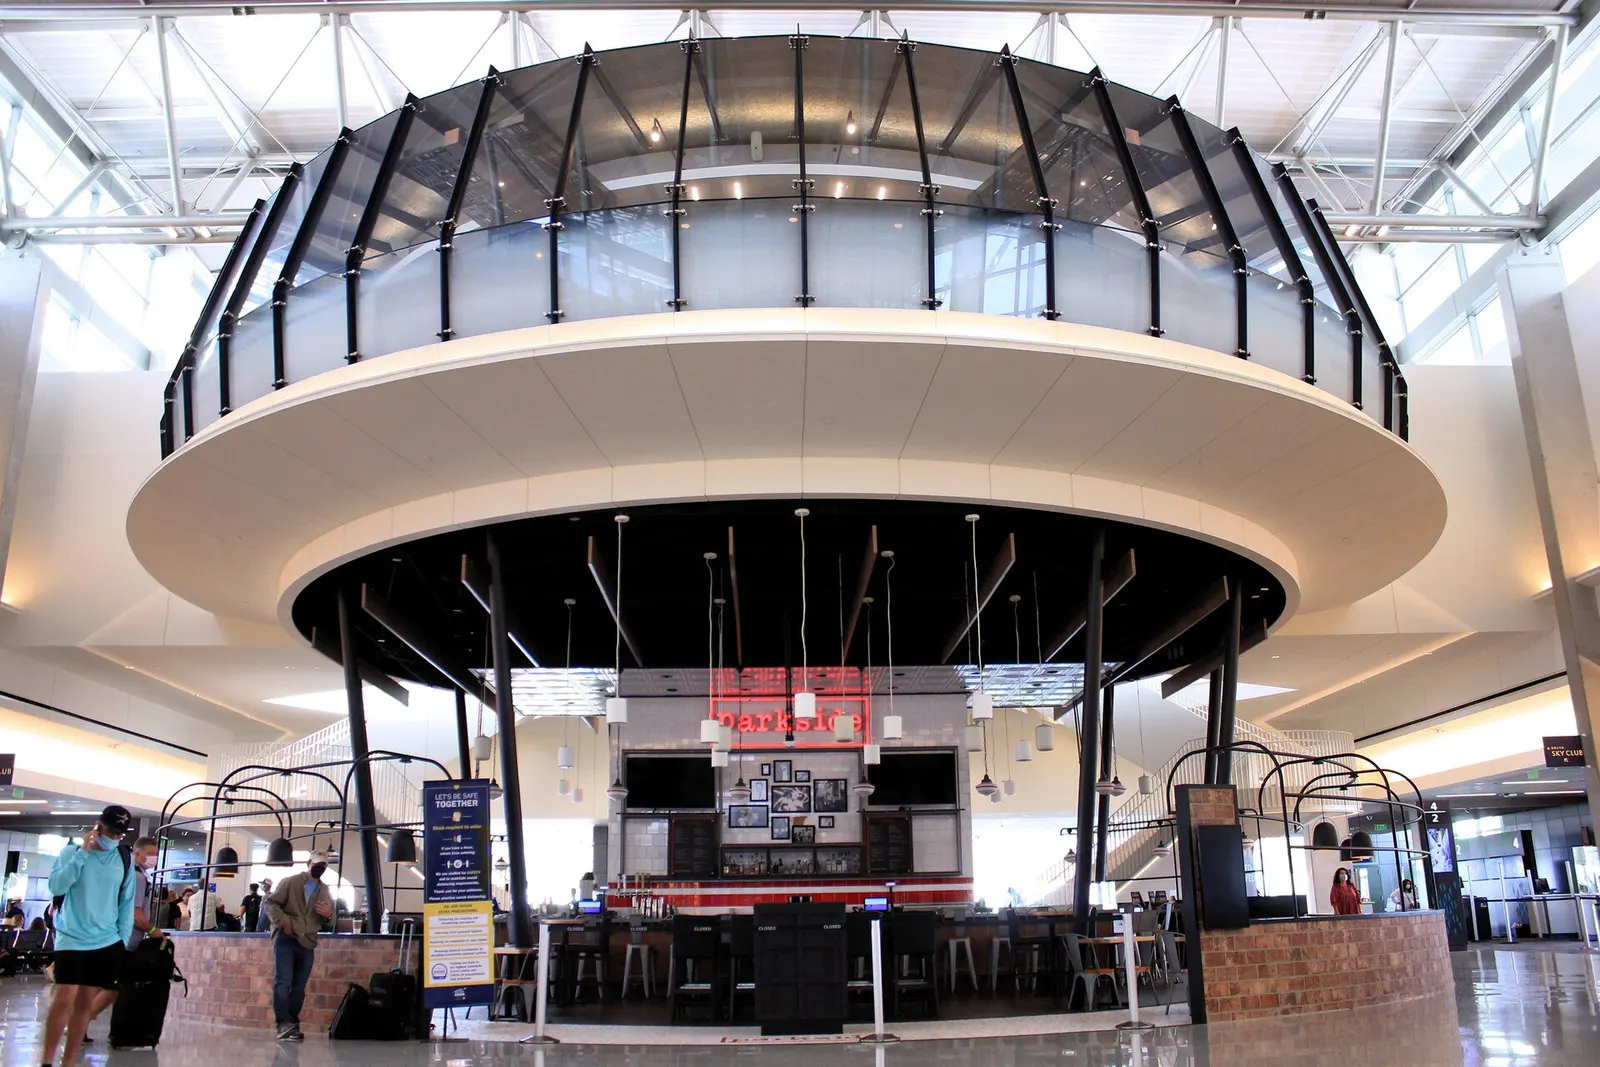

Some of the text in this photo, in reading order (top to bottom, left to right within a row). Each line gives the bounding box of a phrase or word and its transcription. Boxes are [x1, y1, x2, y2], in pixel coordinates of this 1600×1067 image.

[435, 800, 478, 808] TOGETHER
[1430, 802, 1438, 810] 4
[1431, 814, 1439, 822] 2
[1513, 838, 1520, 848] 4
[1456, 845, 1461, 855] 2
[22, 859, 28, 870] 3
